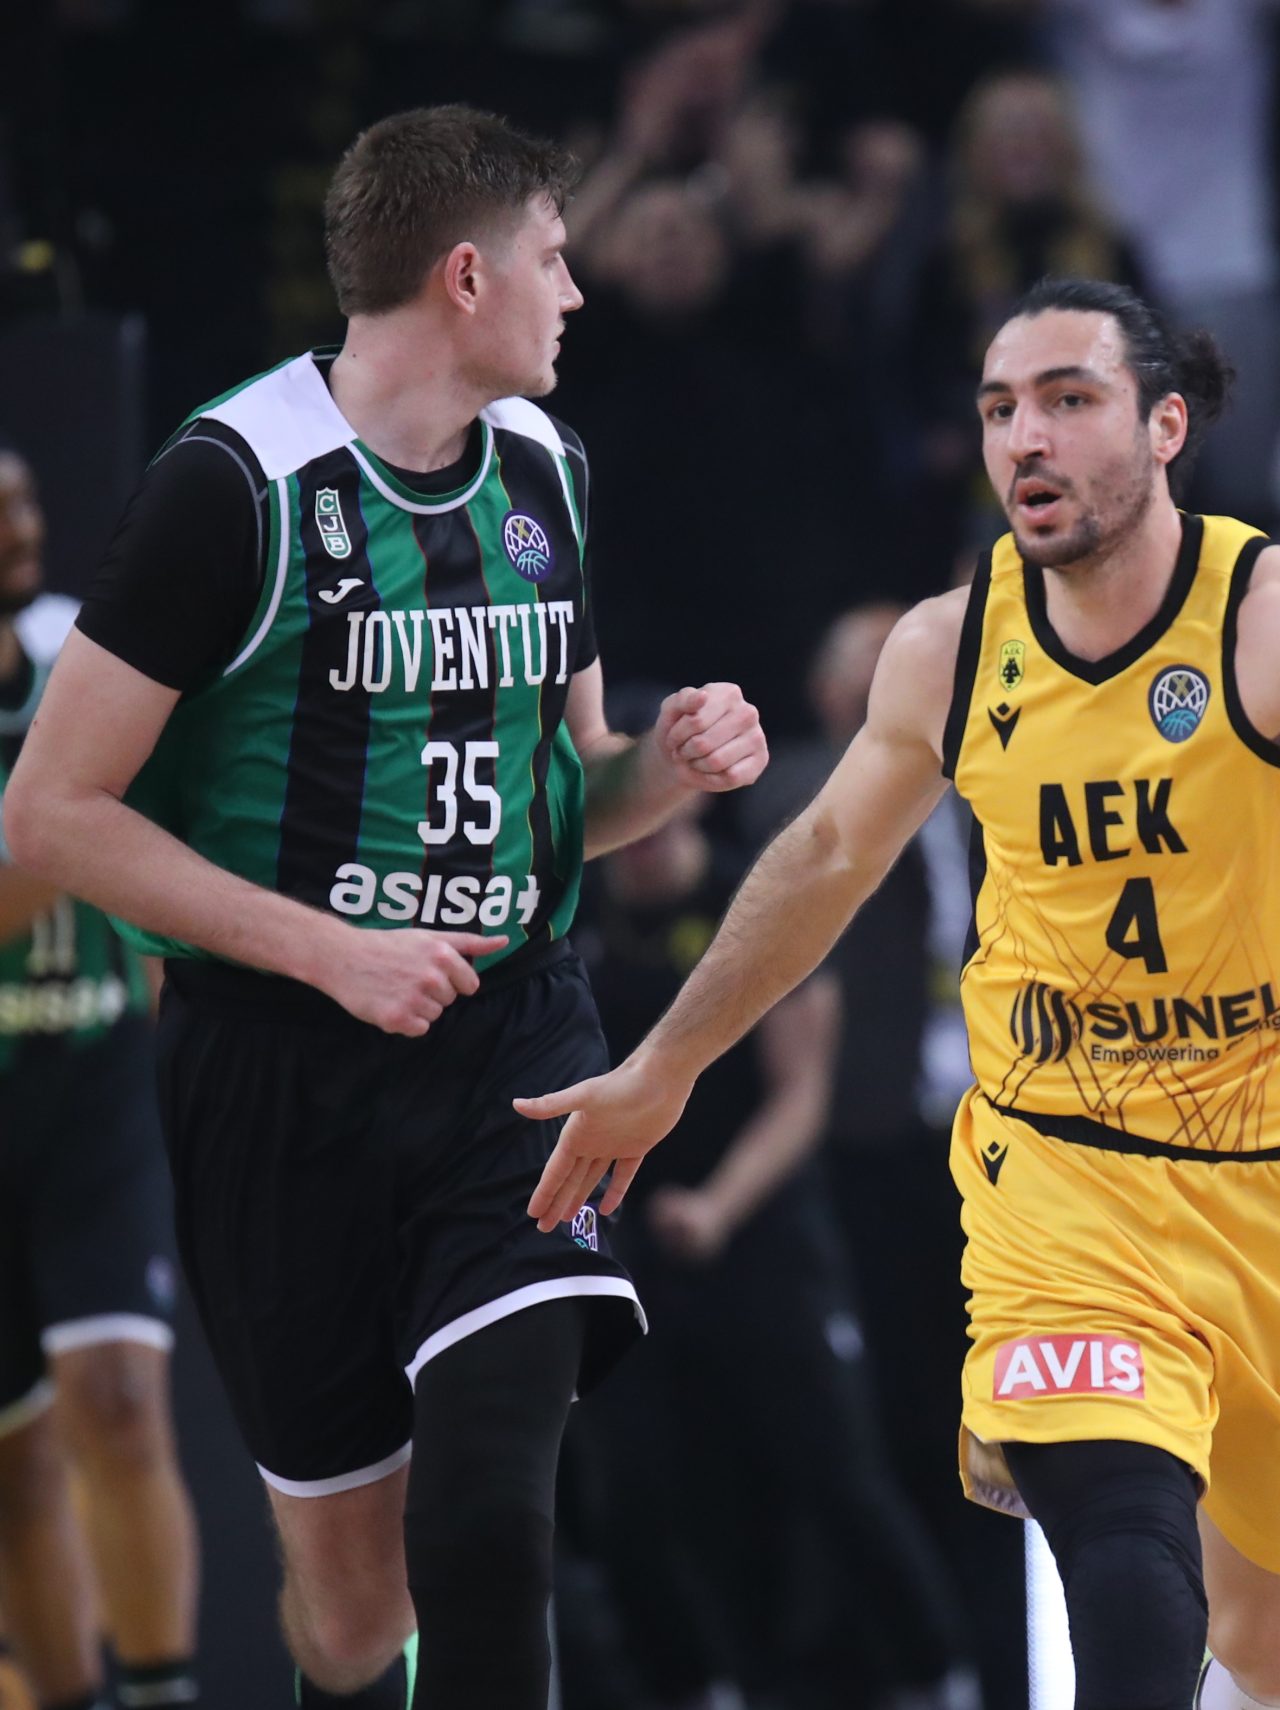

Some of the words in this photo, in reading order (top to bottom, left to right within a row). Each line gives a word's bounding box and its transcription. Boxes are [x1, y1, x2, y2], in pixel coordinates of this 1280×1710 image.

[329, 600, 574, 693] JOVENTUT
[417, 741, 502, 845] 35
[1039, 778, 1188, 867] AEK
[1105, 877, 1168, 975] 4
[998, 1340, 1141, 1396] AVIS
